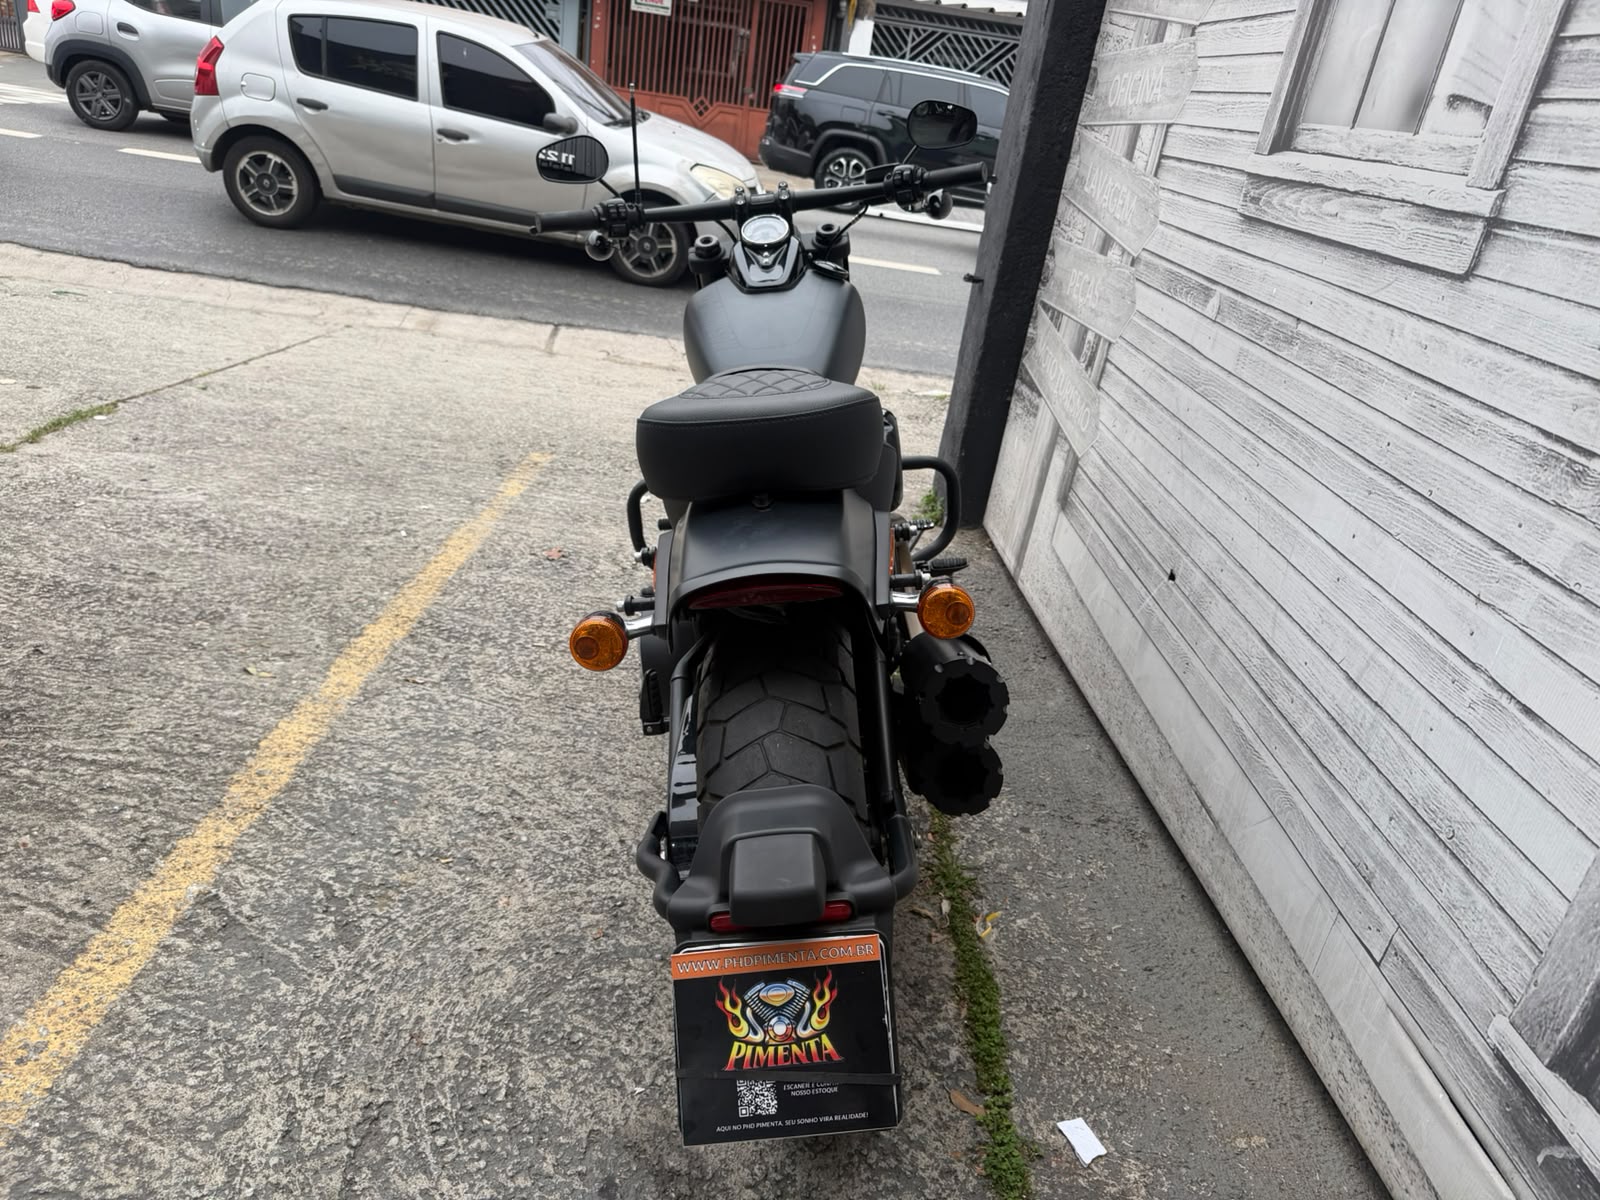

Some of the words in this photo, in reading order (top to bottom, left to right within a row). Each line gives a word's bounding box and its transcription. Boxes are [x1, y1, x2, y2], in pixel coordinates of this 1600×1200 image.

[1108, 65, 1165, 107] OFICINA
[1083, 162, 1138, 226] LAVAGEM
[1066, 268, 1101, 310] PEÇAS
[676, 943, 875, 974] WWW.PHDPIMENTA.COM.BR
[722, 1033, 846, 1072] PIMENTA
[811, 1086, 839, 1095] ESTOQUE
[797, 1117, 819, 1125] SONHO
[819, 1115, 834, 1123] VIRA
[834, 1112, 869, 1121] REALIDADE!
